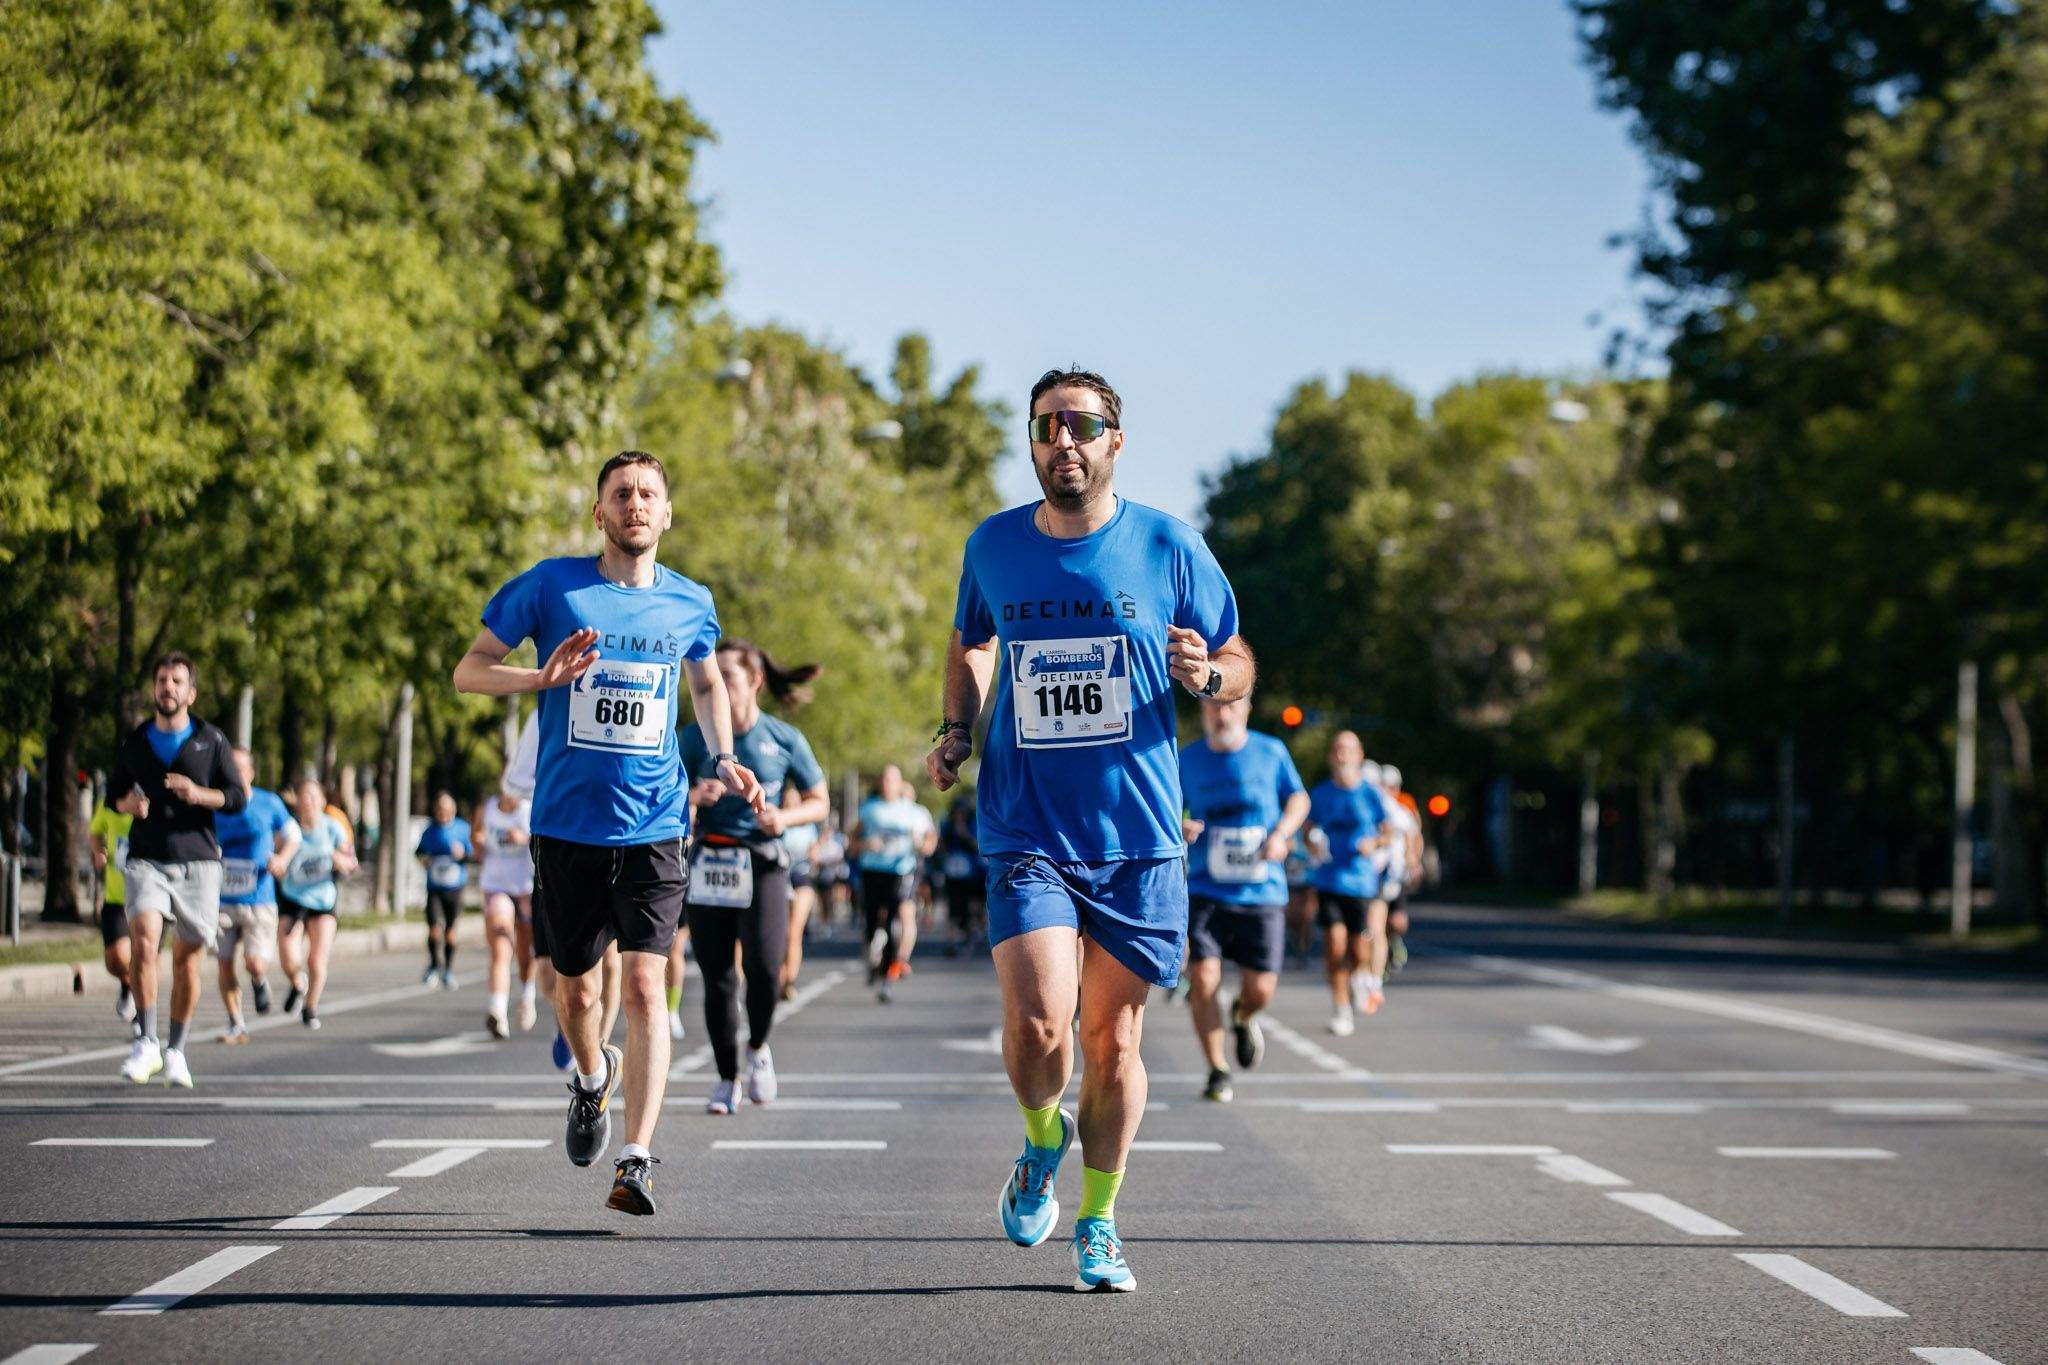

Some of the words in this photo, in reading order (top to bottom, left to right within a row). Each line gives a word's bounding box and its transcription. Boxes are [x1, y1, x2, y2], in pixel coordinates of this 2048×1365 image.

[1003, 600, 1136, 622] DECIMAS
[592, 633, 678, 657] CIMAS
[1046, 653, 1103, 664] BOMBEROS
[1041, 671, 1103, 682] DECIMAS
[1034, 683, 1103, 717] 1146
[595, 697, 645, 727] 680
